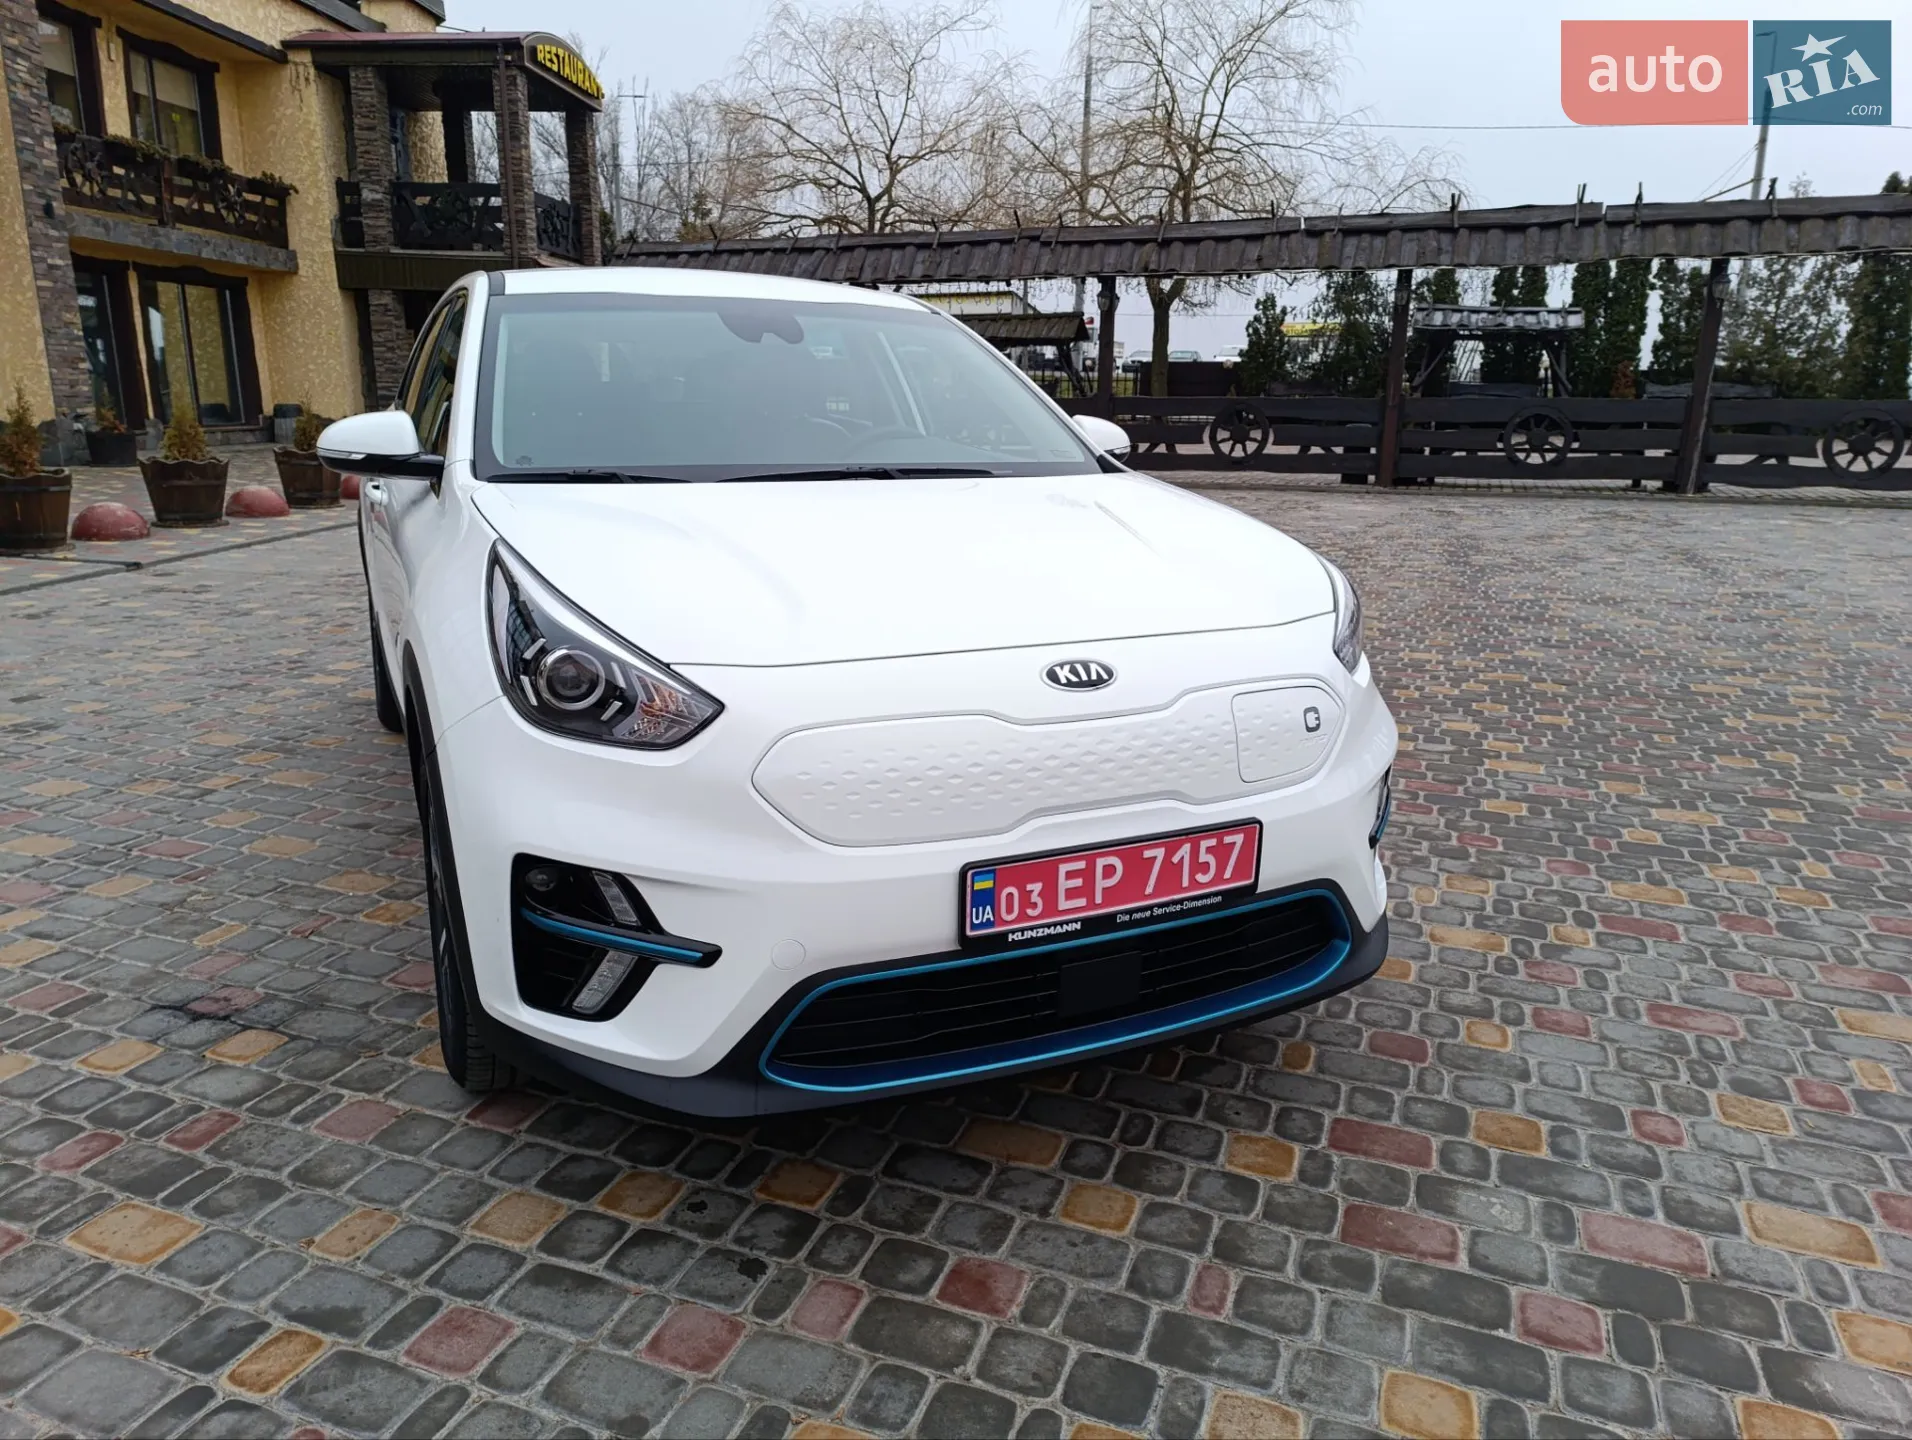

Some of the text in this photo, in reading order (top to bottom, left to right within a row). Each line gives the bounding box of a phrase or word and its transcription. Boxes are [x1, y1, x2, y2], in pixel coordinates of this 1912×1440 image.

[1052, 662, 1109, 684] KIA
[1000, 832, 1245, 922] 03 EP 7157
[972, 904, 995, 924] UA
[1116, 895, 1223, 923] Die neue Service-Dimension
[1007, 921, 1082, 942] KUNZMANN
